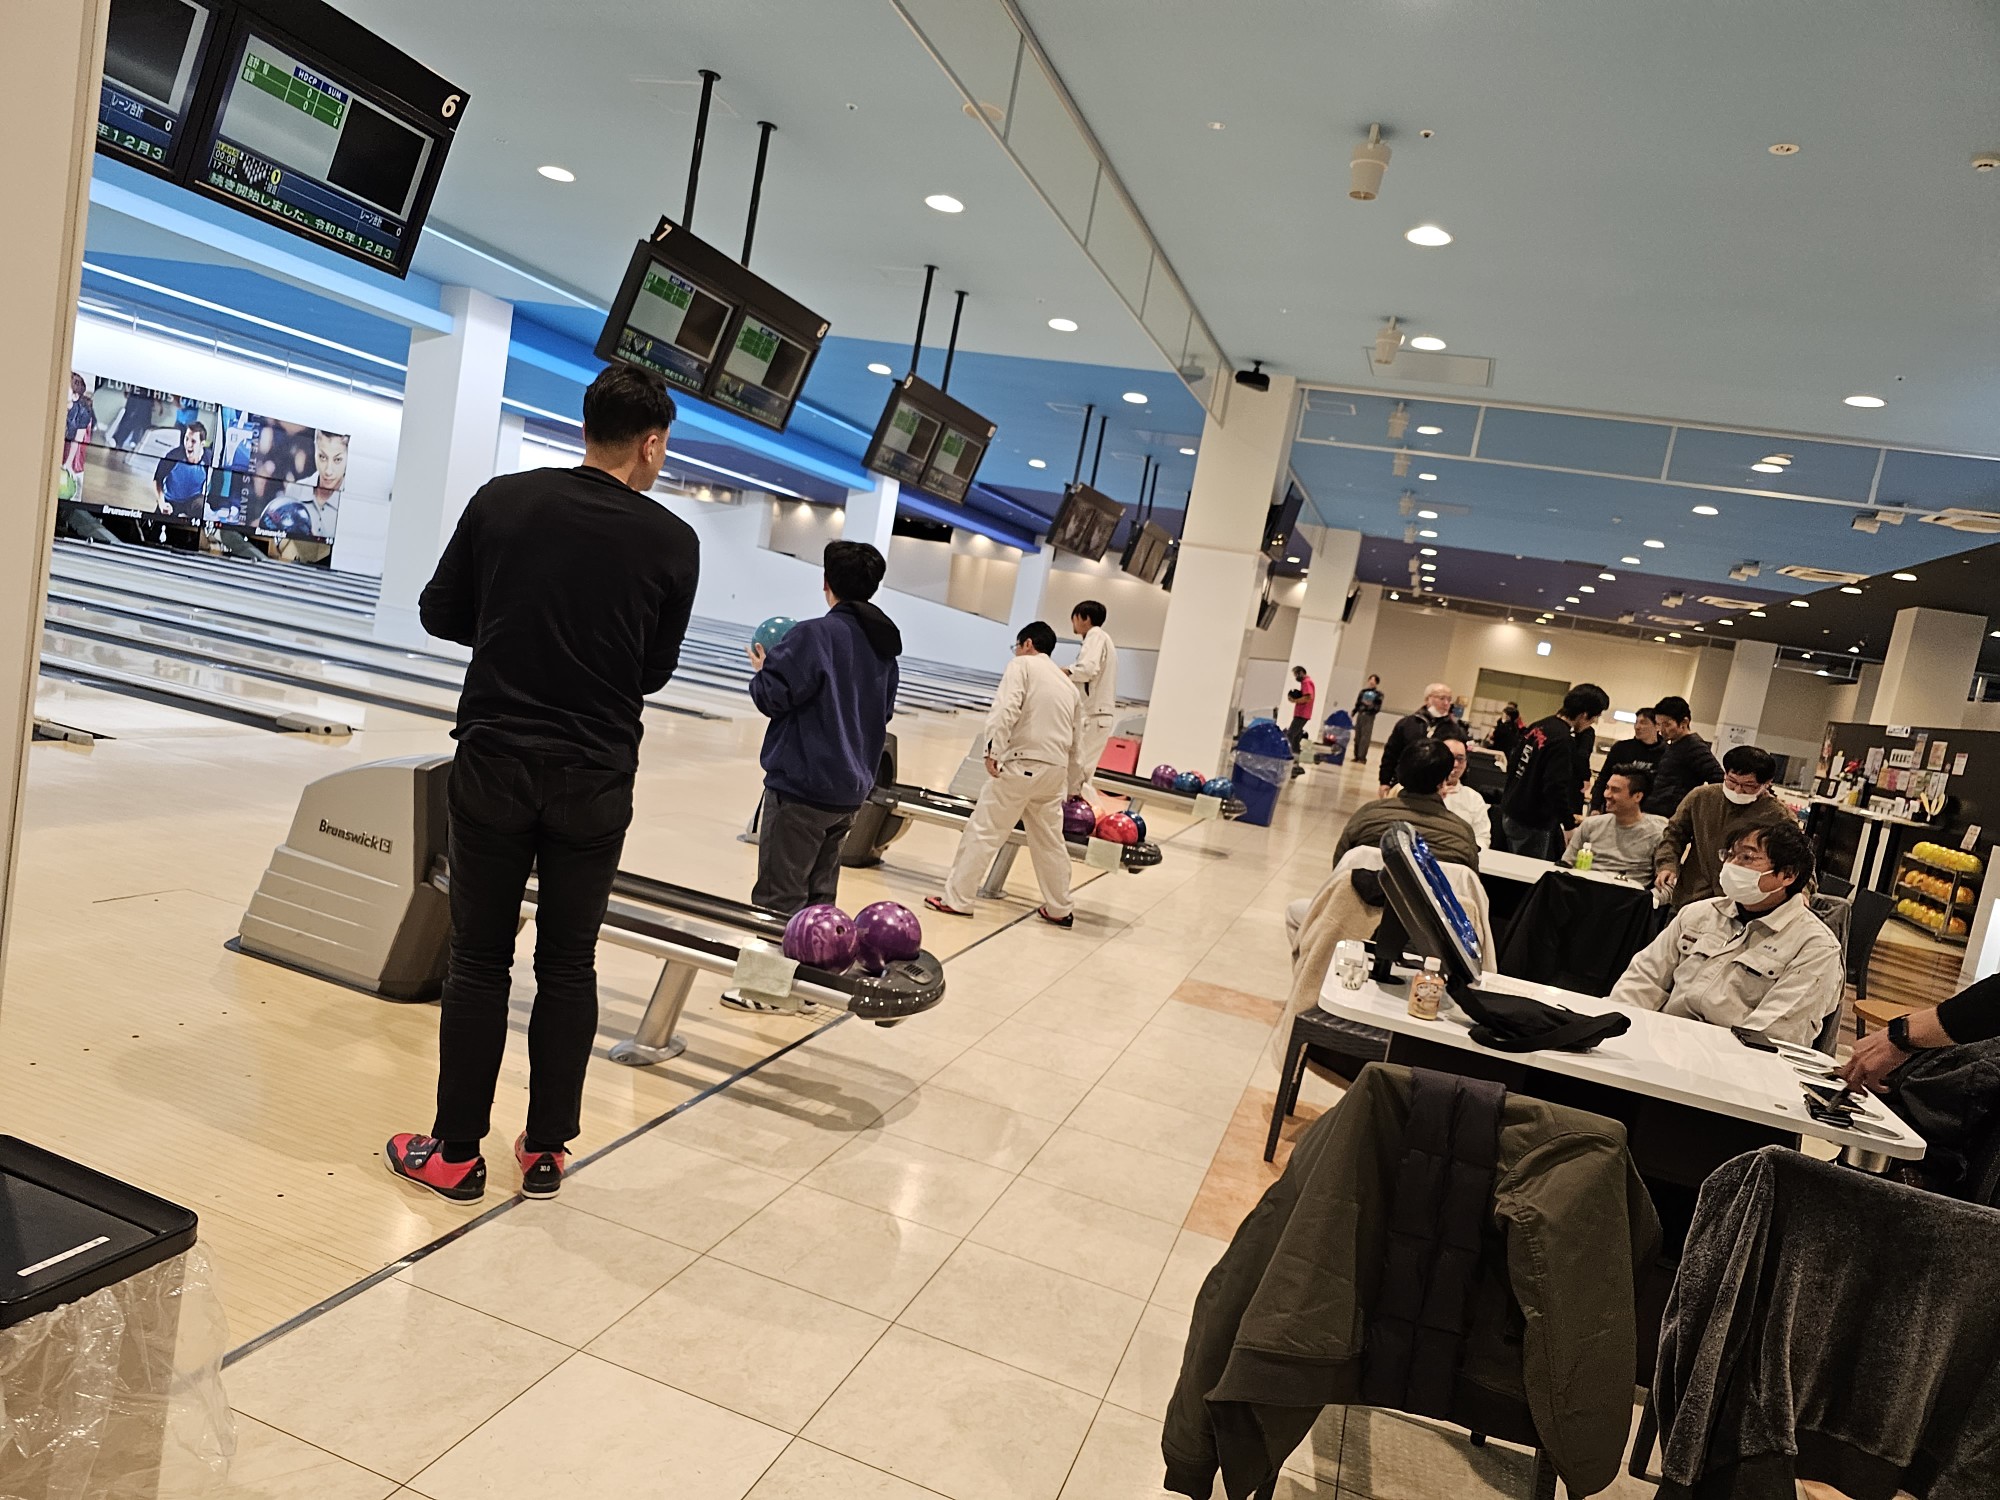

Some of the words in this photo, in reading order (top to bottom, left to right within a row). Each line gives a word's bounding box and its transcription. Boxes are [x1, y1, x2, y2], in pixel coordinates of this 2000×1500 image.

[298, 69, 318, 86] HDCP
[327, 85, 342, 100] SUM
[302, 100, 309, 111] 0
[332, 116, 339, 127] 0
[306, 88, 313, 99] 0
[336, 104, 343, 115] 0
[441, 94, 461, 118] 6
[164, 119, 172, 132] 0
[396, 227, 402, 237] 0
[656, 223, 673, 242] 7
[816, 322, 828, 339] 8
[903, 375, 914, 390] 9
[107, 379, 141, 395] LOVE
[146, 388, 175, 403] THIS
[179, 395, 217, 412] GAME!
[243, 457, 257, 484] THS
[102, 504, 143, 519] Brunswick
[318, 818, 380, 850] Brunswick
